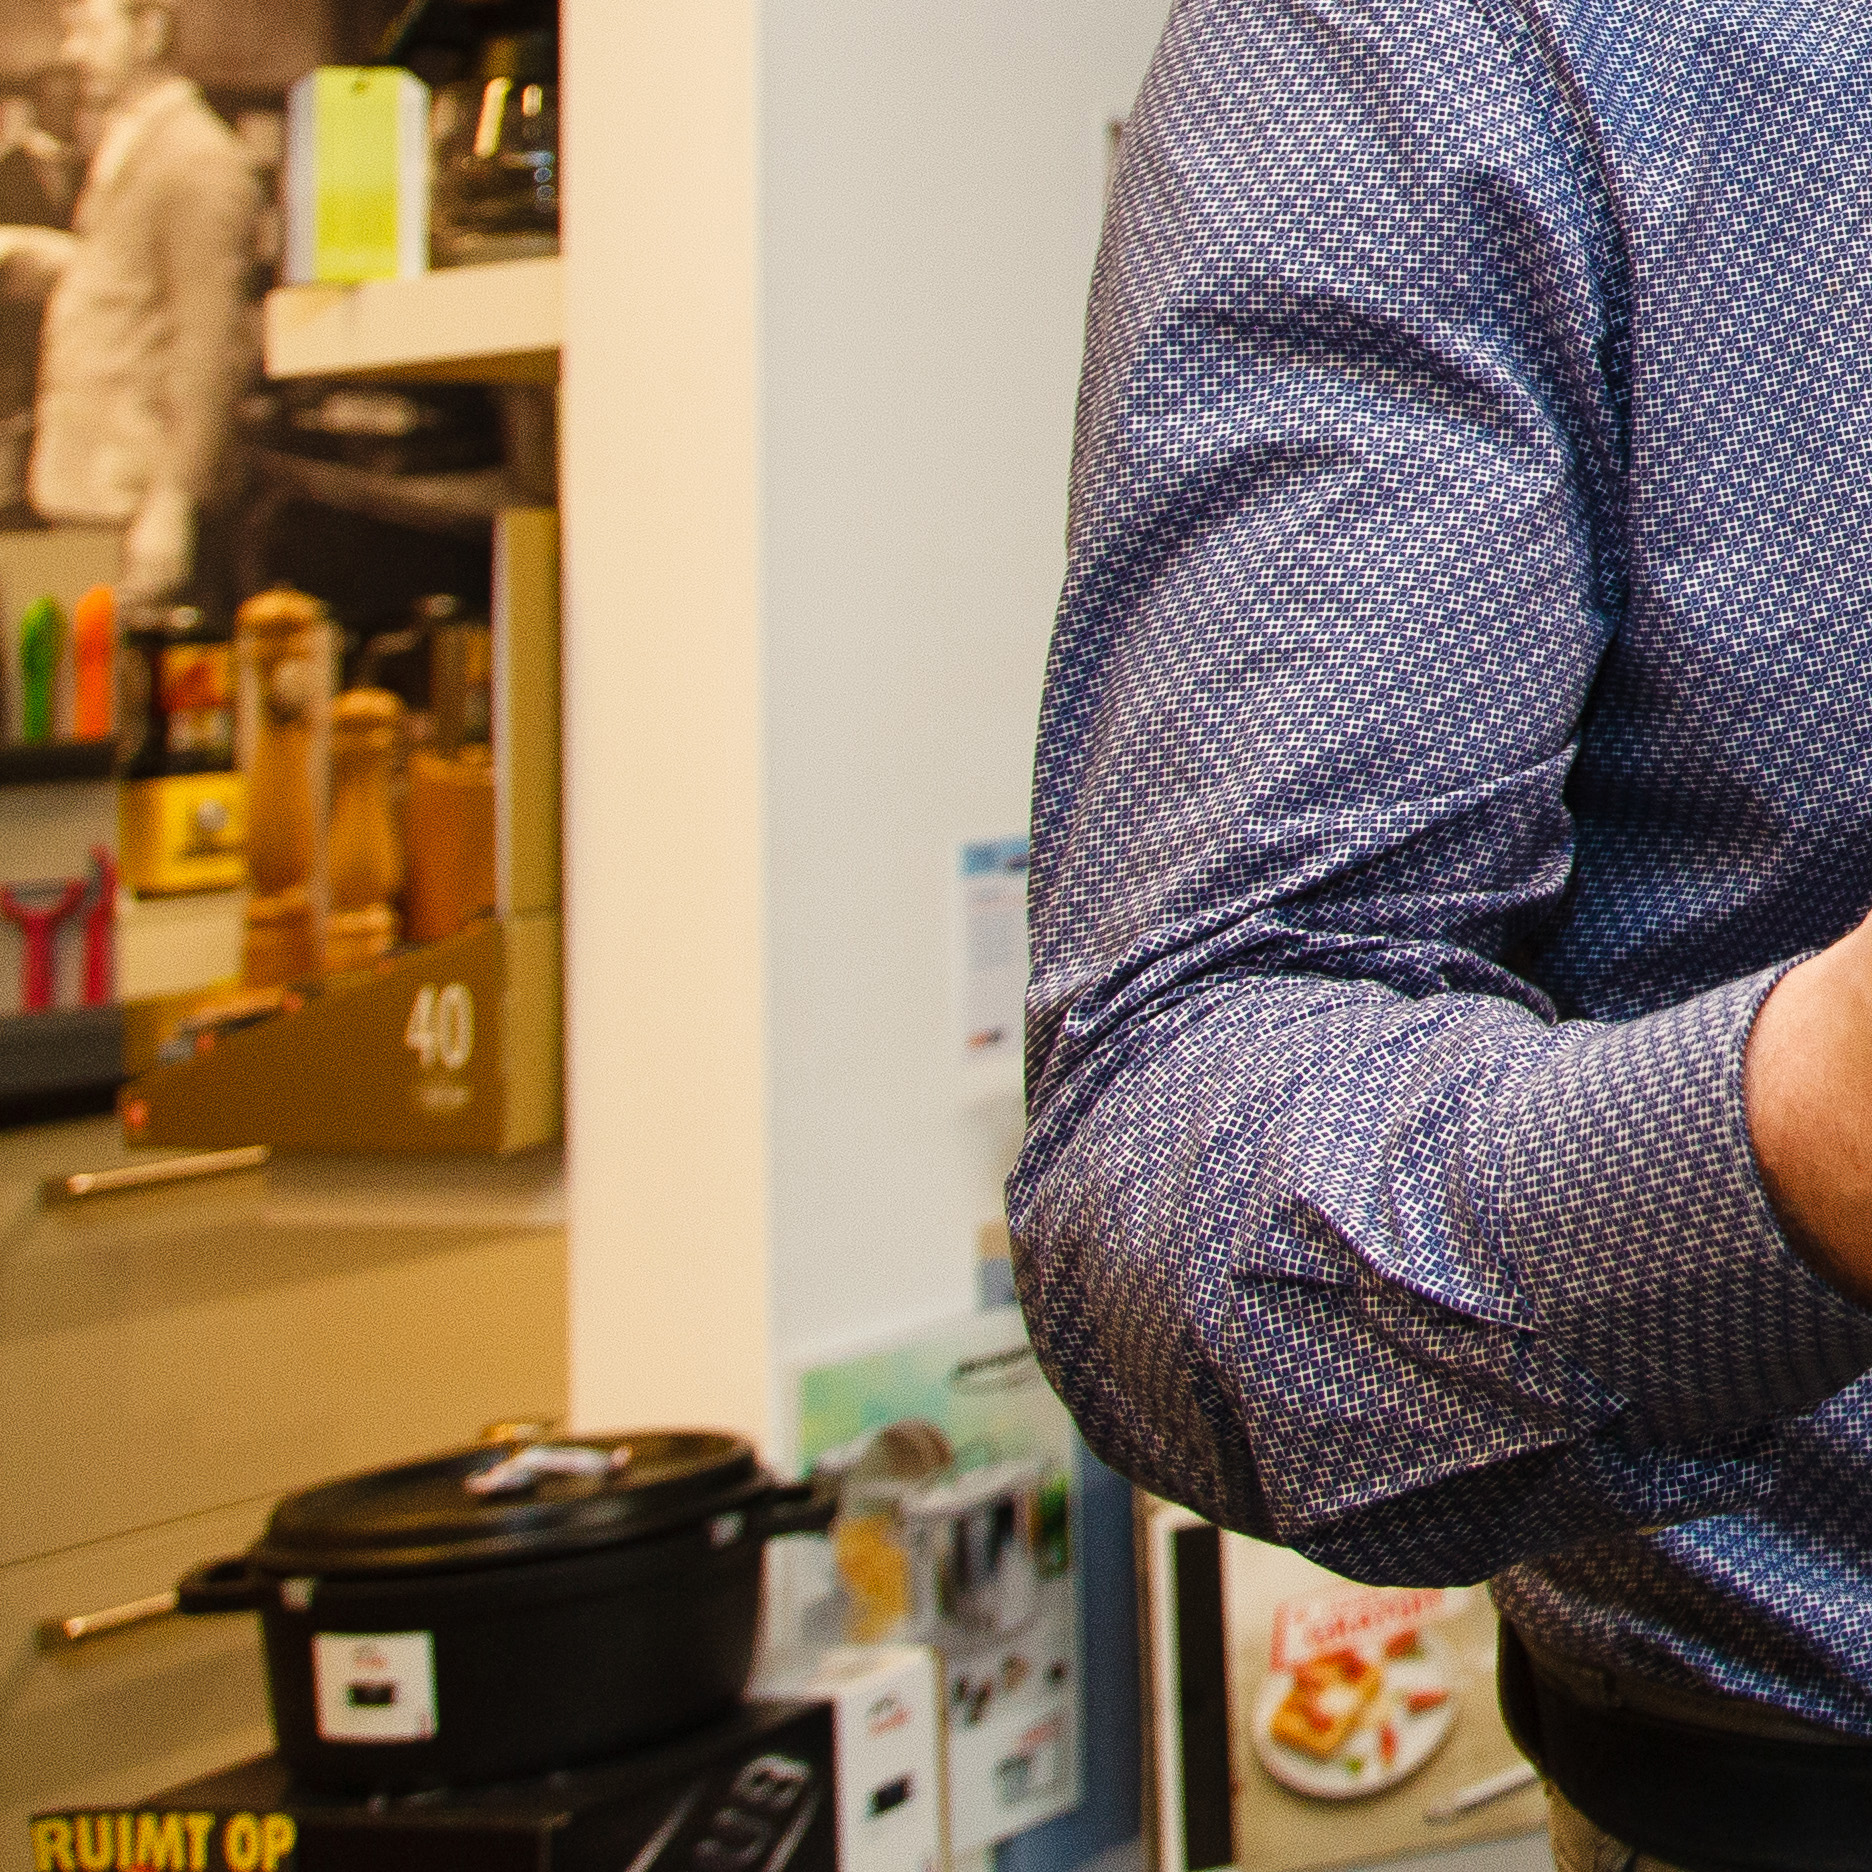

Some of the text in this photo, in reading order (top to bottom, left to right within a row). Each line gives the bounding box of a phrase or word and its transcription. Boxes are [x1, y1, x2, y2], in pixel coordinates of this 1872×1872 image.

[402, 982, 475, 1071] 40
[30, 1812, 298, 1872] RUIMT OP
